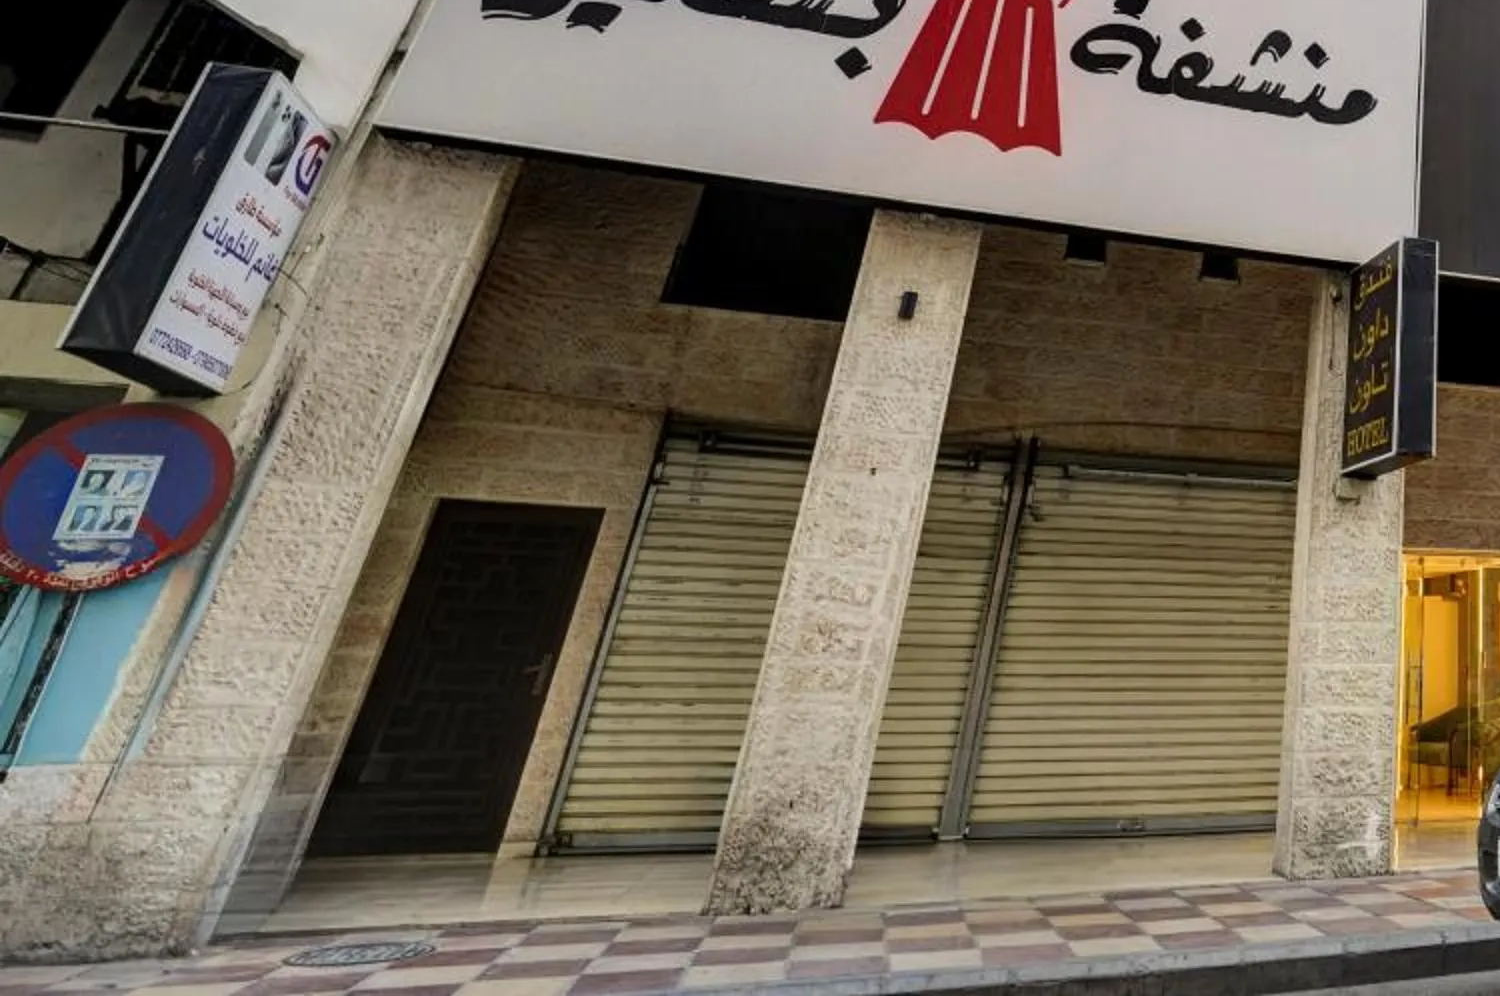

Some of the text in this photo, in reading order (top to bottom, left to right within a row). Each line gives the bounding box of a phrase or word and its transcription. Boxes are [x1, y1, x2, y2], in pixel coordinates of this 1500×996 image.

[202, 215, 260, 266] للخلويات
[1353, 254, 1394, 312] فندق
[1353, 307, 1390, 360] داون
[1349, 361, 1390, 415] تاون
[1346, 415, 1389, 457] HOTEL
